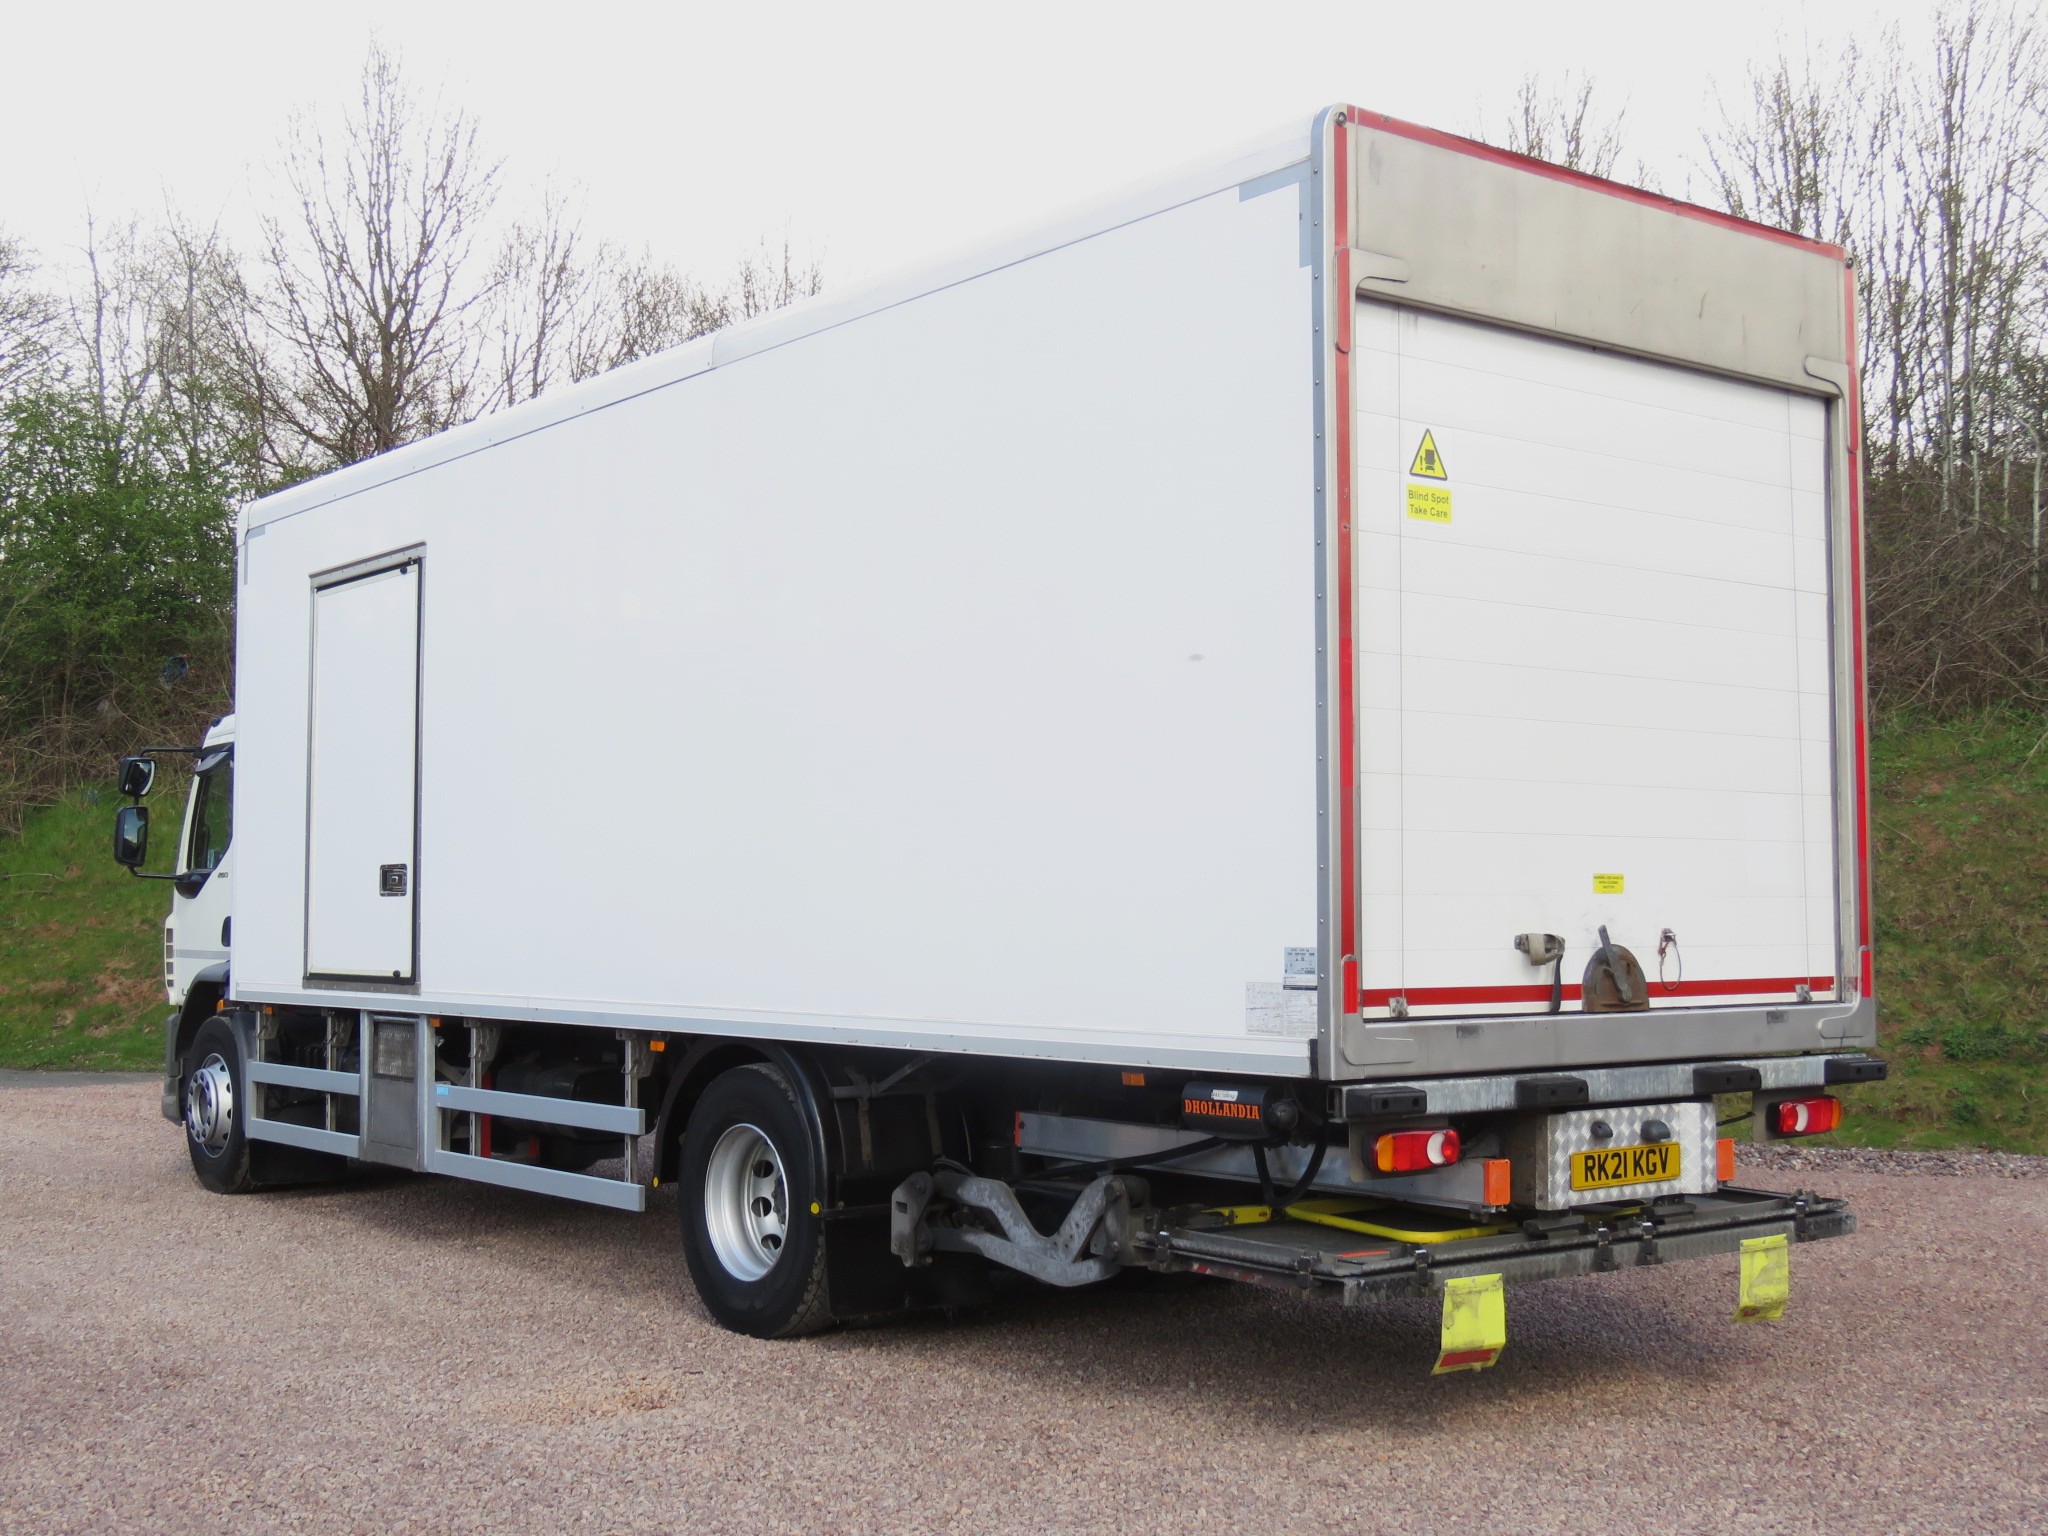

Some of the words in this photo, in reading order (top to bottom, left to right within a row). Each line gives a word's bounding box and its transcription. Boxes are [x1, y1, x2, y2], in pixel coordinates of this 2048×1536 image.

[1408, 489, 1429, 502] Blind
[1431, 493, 1449, 505] Spot
[1409, 503, 1428, 516] Take
[1430, 507, 1448, 518] Care
[1184, 1099, 1260, 1120] DHOLLANDIA
[1584, 1151, 1628, 1182] RK21
[1633, 1147, 1669, 1177] KGV
